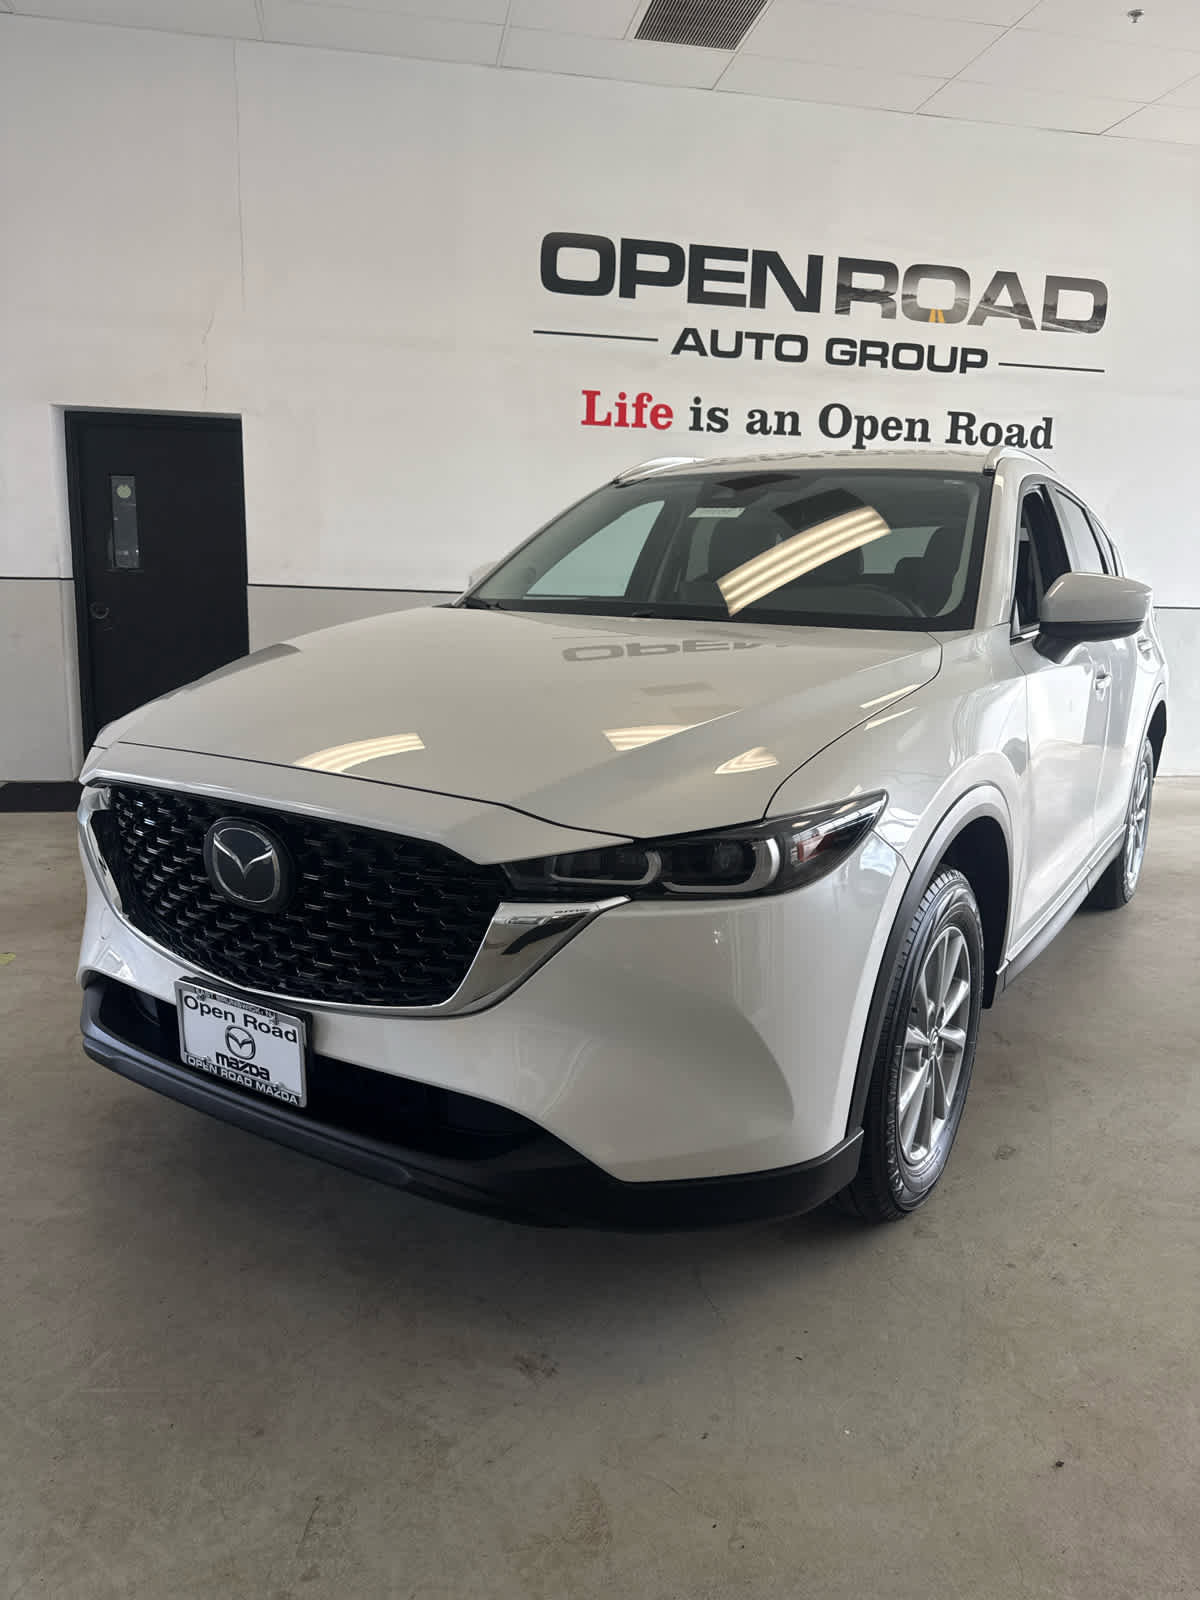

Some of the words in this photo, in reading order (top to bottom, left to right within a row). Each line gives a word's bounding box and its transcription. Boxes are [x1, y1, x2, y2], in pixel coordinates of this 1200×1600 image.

[671, 328, 809, 363] AUTO
[824, 337, 989, 374] GROUP
[581, 390, 675, 431] Life
[689, 397, 729, 434] is
[746, 409, 802, 437] an
[819, 404, 930, 450] Open
[945, 411, 1054, 450] Road
[184, 995, 236, 1023] Open
[243, 1013, 298, 1044] Road
[188, 1055, 218, 1075] OPEN
[221, 1068, 253, 1087] ROAD
[256, 1081, 298, 1105] MAZDA
